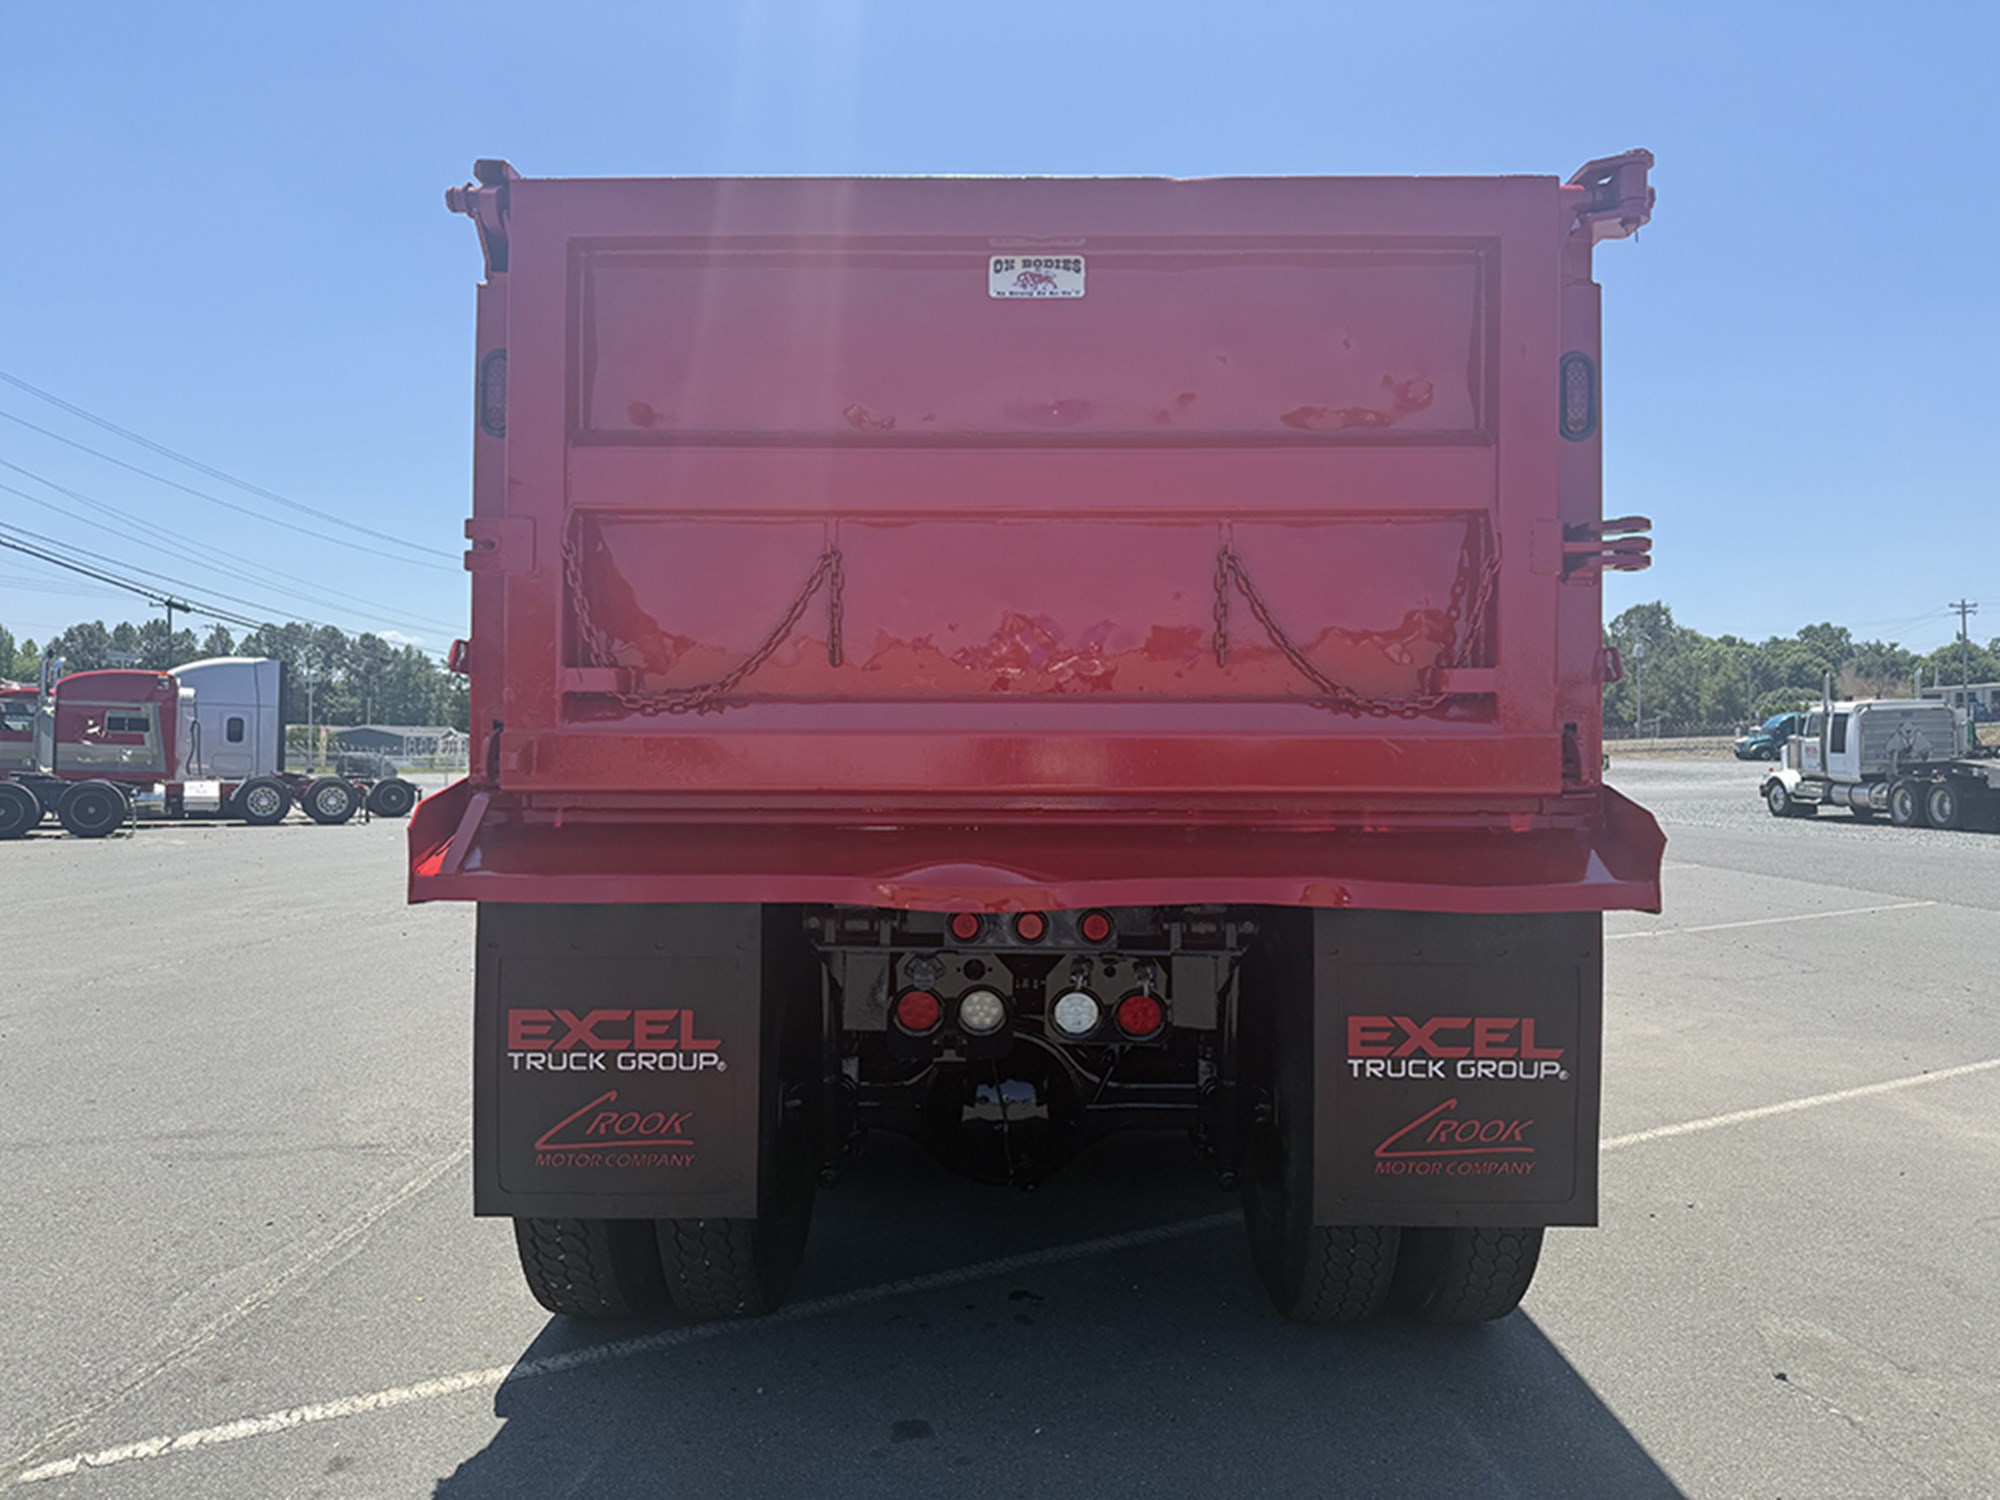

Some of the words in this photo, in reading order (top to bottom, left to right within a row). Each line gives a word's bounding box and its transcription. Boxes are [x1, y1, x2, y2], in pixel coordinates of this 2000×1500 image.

[1022, 259, 1082, 274] BODIES
[508, 1009, 722, 1050] EXCEL
[1348, 1016, 1565, 1059] EXCEL
[508, 1052, 606, 1071] TRUCK
[1347, 1059, 1446, 1079] TRUCK
[535, 1153, 602, 1168] MOTOR
[605, 1153, 695, 1168] COMPANY
[1375, 1160, 1443, 1176] MOTOR
[1446, 1160, 1536, 1176] COMPANY
